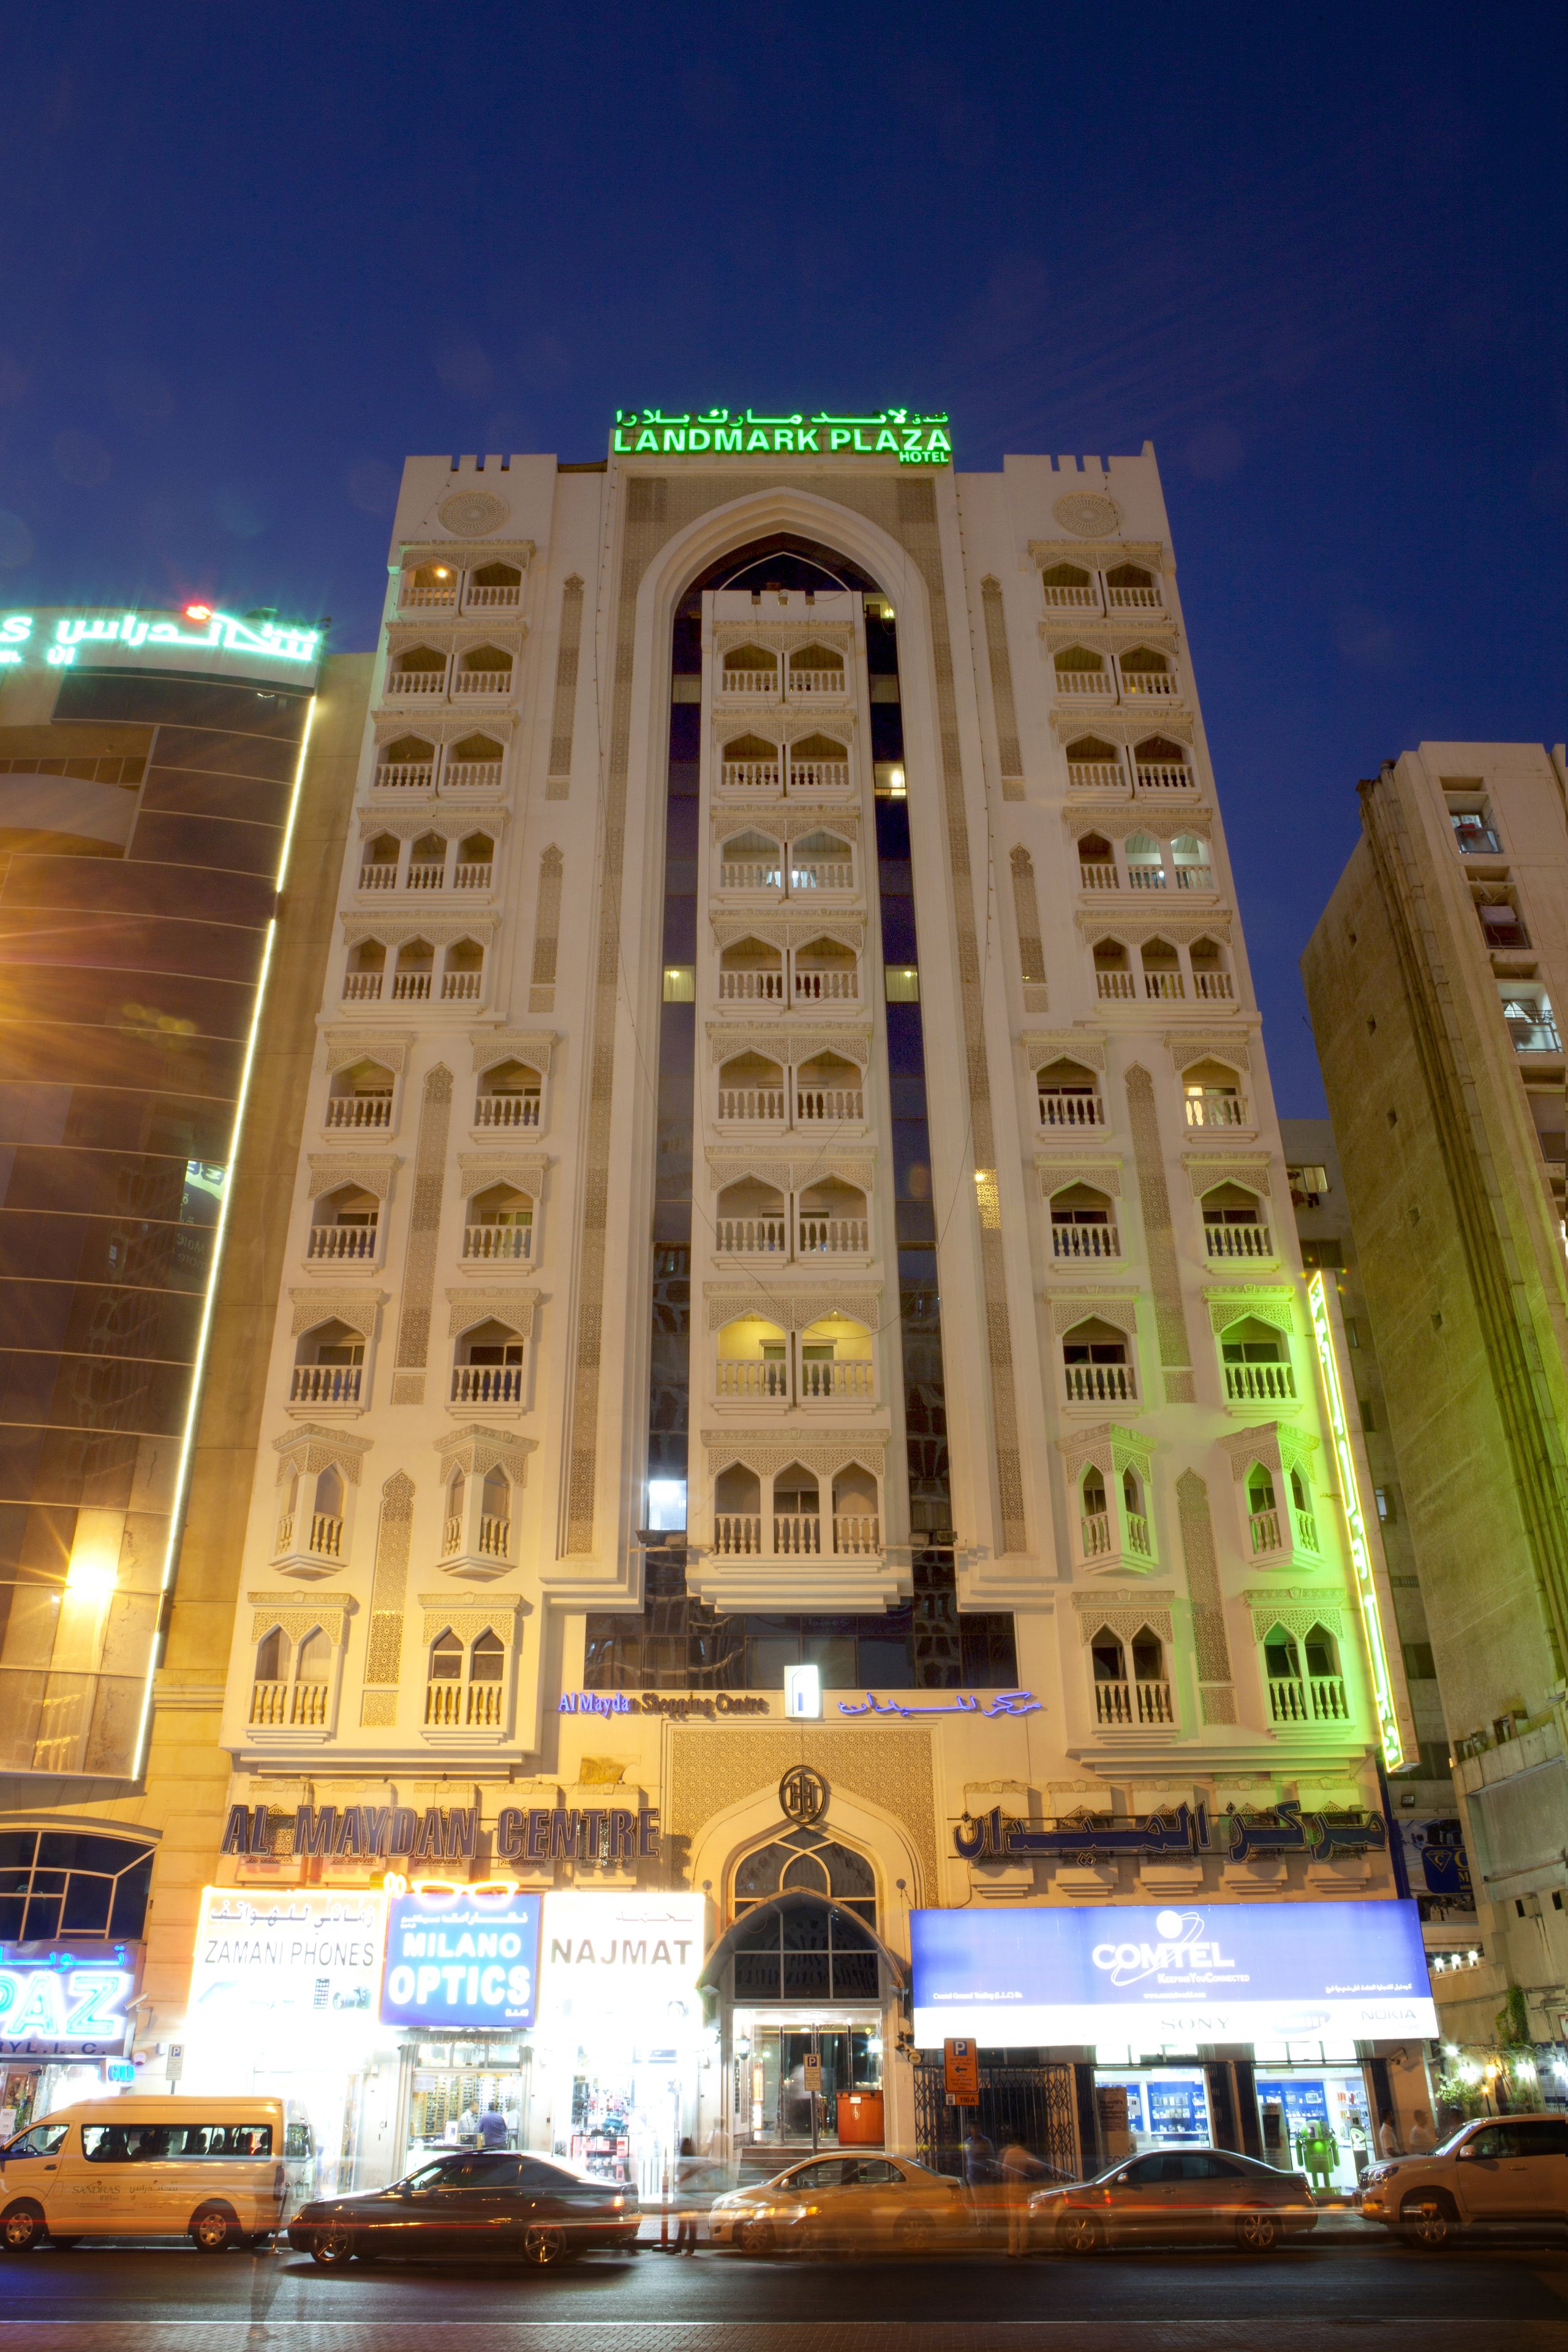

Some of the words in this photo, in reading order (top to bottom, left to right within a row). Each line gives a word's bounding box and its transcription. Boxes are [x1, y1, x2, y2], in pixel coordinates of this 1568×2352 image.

[614, 429, 820, 452] LANDMARK
[830, 428, 952, 452] PLAZA
[899, 451, 949, 463] HOTEL
[558, 1692, 576, 1712] Al
[578, 1692, 637, 1717] Maydan
[641, 1692, 714, 1717] Shopping
[715, 1692, 767, 1713] Centre
[982, 1691, 1041, 1716] مركز
[220, 1804, 272, 1856] AL
[292, 1804, 477, 1860] MAYDAN
[497, 1807, 663, 1860] CENTRE
[953, 1800, 1212, 1869] الميدان
[1227, 1800, 1389, 1863] مركز
[210, 1899, 311, 1928] للهواتف
[204, 1939, 284, 1965] ZAMANI
[290, 1941, 375, 1967] PHONES
[402, 1932, 522, 1958] MILANO
[551, 1938, 694, 1966] NAJMAT
[1092, 1941, 1235, 1970] COMTEL
[388, 1964, 530, 2005] OPTICS
[1161, 2018, 1229, 2030] SONY
[1361, 2009, 1417, 2020] NOKIA
